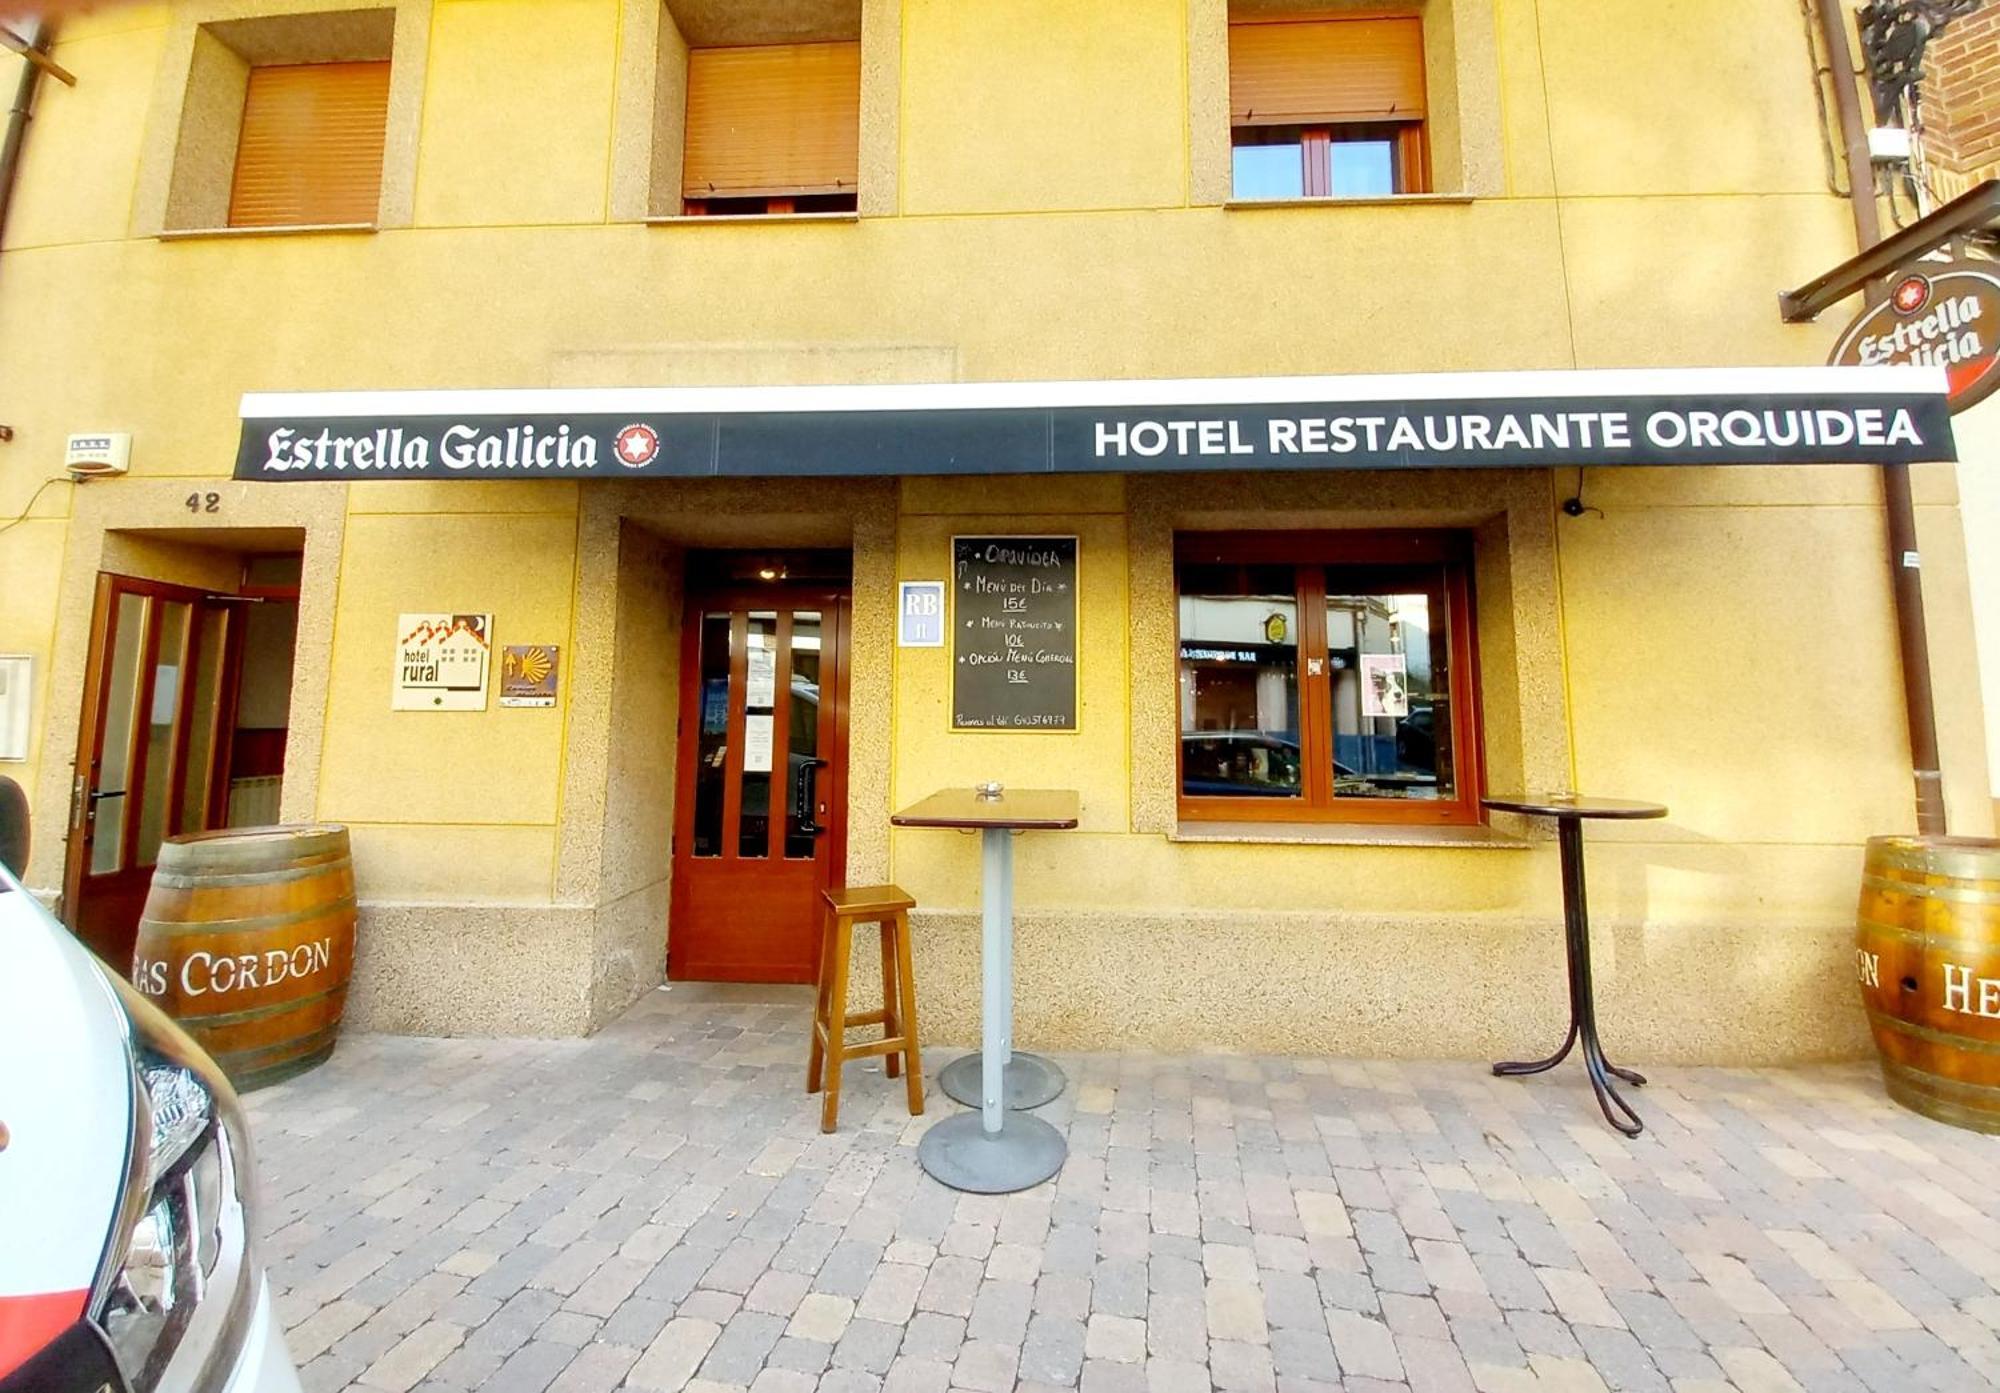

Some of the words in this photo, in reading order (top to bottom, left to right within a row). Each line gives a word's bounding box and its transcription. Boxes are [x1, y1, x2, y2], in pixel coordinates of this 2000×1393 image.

[1858, 295, 1983, 366] Estrella
[1886, 331, 1983, 366] licia
[263, 426, 430, 471] Estrella
[439, 424, 599, 470] Galicia
[1095, 420, 1254, 457] HOTEL
[1268, 412, 1632, 455] RESTAURANTE
[1645, 408, 1923, 448] ORQUIDEA
[185, 492, 220, 513] 42
[906, 593, 938, 616] RB
[402, 659, 440, 682] rural
[404, 649, 430, 663] hotel
[181, 938, 331, 996] CORDON
[1942, 963, 2000, 1019] HE
